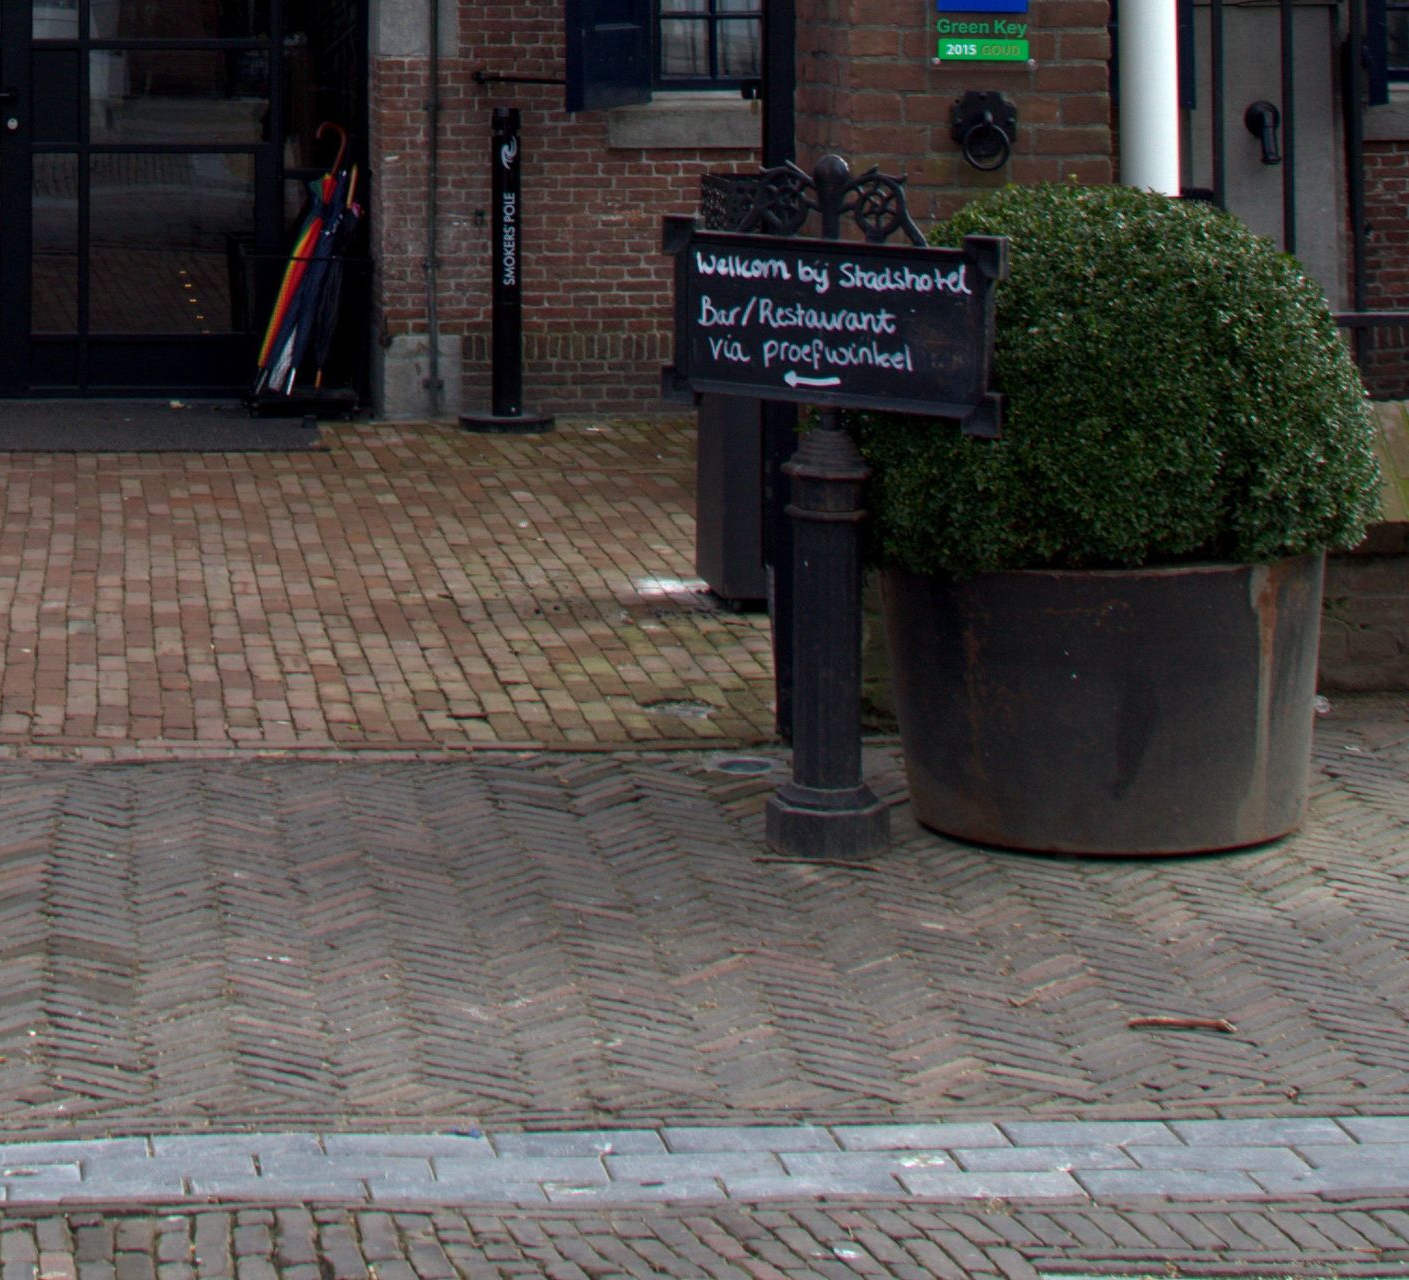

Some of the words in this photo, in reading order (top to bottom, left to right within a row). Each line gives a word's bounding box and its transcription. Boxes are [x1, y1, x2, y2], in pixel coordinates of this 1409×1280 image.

[936, 18, 990, 34] Green
[994, 19, 1028, 38] Key
[945, 43, 978, 56] 2015
[981, 44, 1021, 56] GOUD
[502, 191, 516, 222] POLE
[797, 258, 830, 293] bij
[838, 262, 972, 296] Stadshotel
[697, 295, 897, 334] Bar/Restaurant
[708, 333, 752, 362] via
[762, 338, 915, 372] proefwinkel
